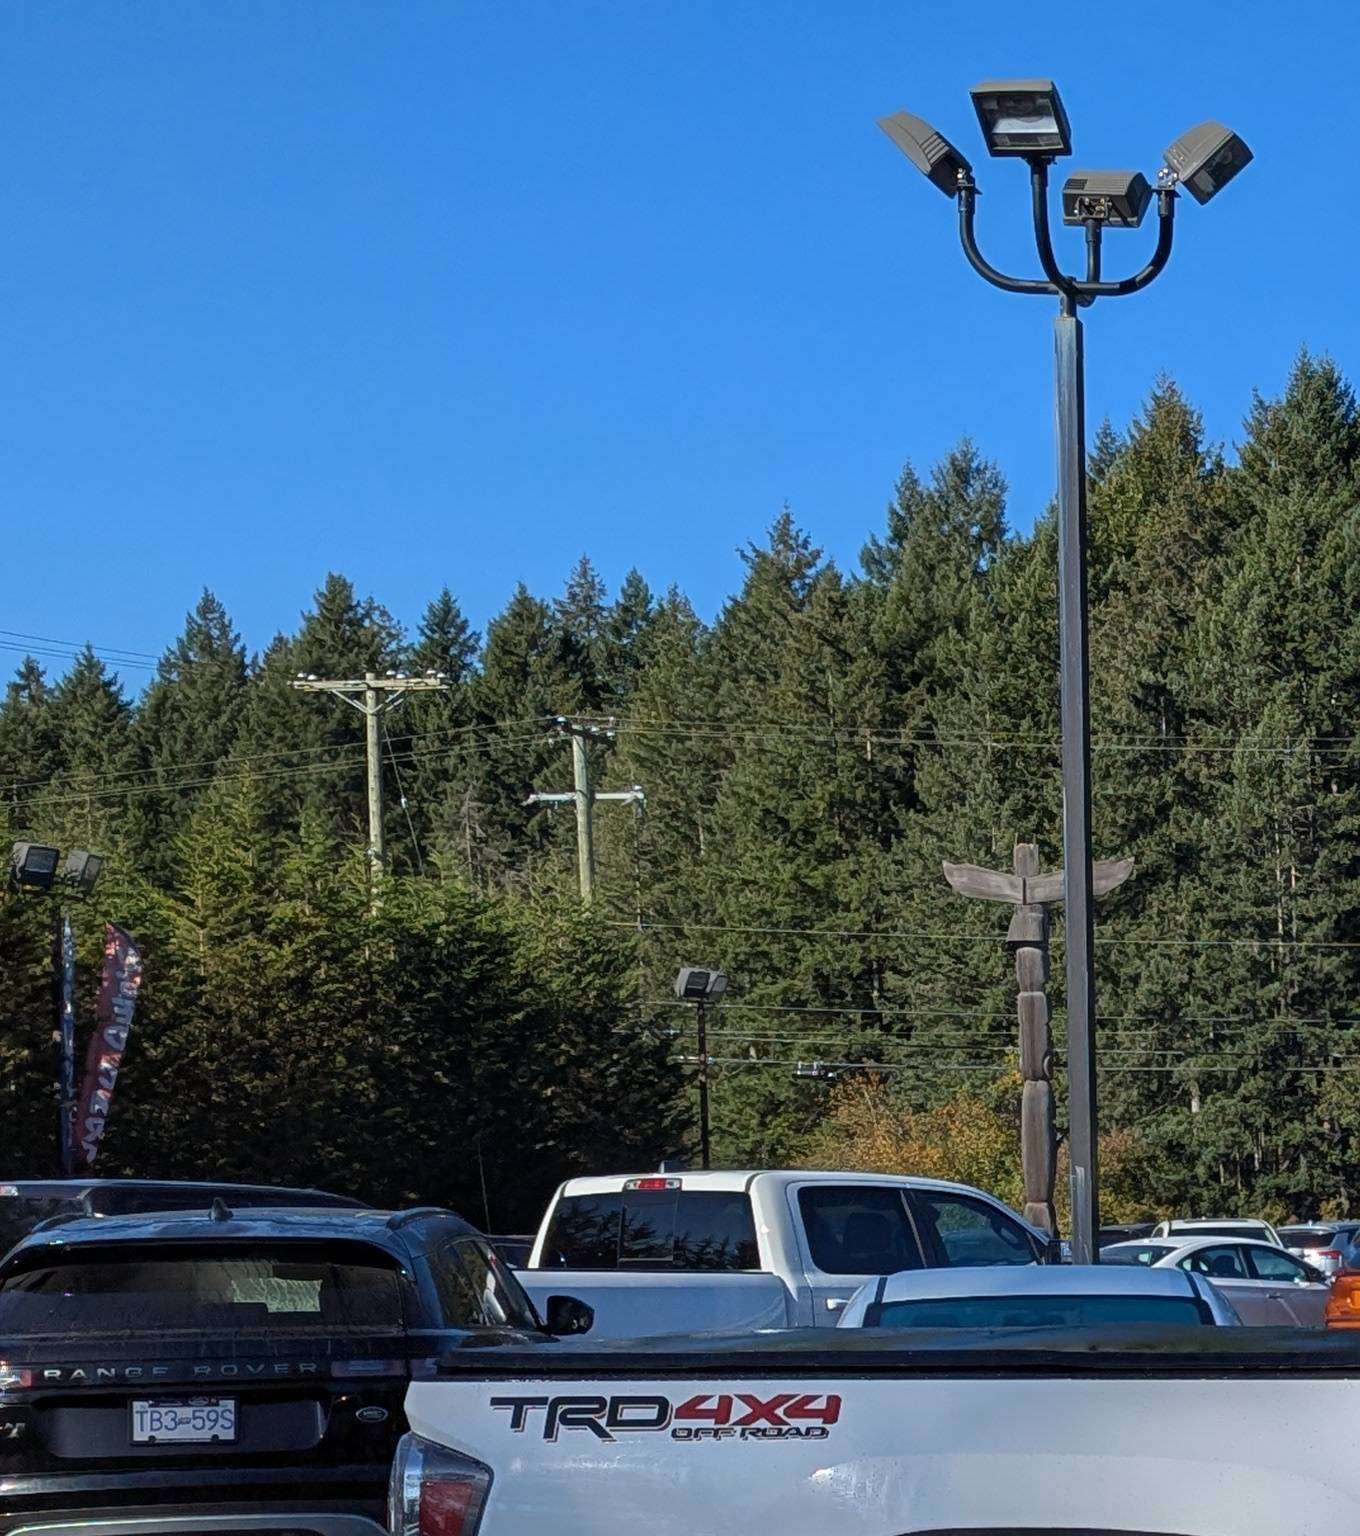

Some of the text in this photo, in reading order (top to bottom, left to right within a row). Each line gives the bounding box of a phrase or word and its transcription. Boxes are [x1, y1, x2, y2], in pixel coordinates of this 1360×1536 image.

[43, 1362, 318, 1380] RANGE ROVER
[489, 1395, 674, 1442] TRD
[671, 1427, 830, 1440] OFF ROAD
